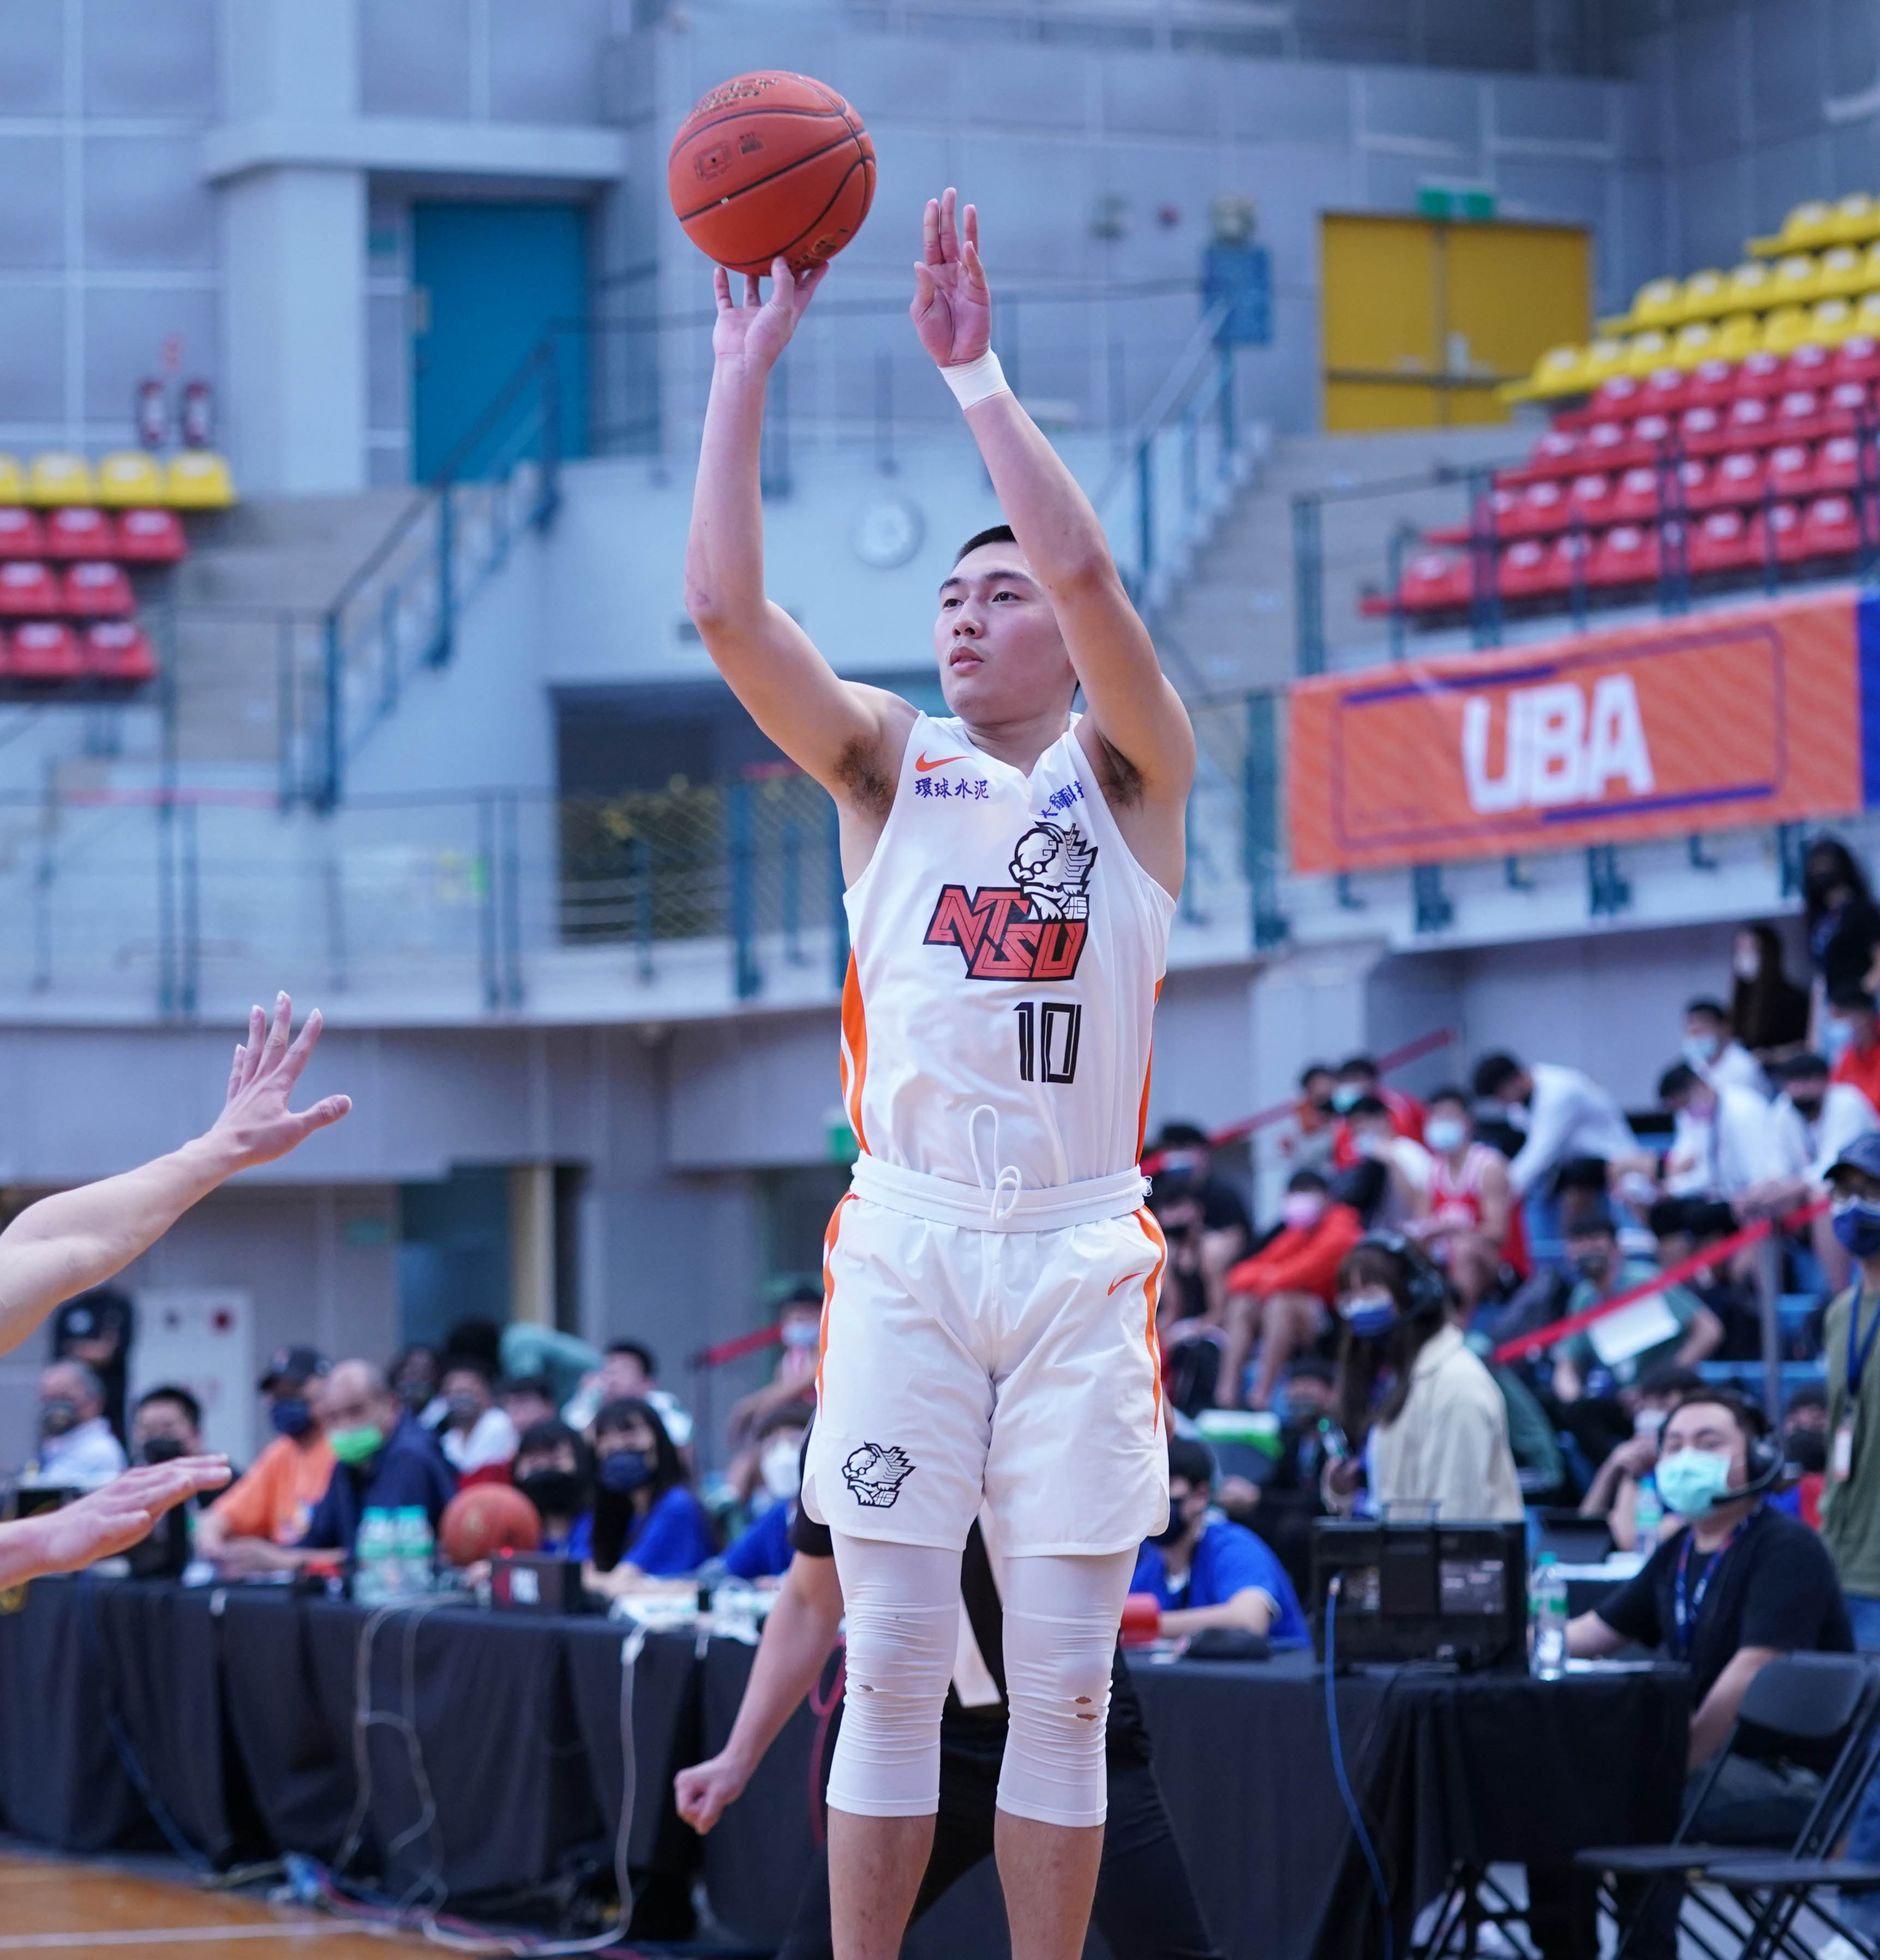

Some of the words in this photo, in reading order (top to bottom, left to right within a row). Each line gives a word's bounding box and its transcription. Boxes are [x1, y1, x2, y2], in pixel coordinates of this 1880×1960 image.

[915, 777, 990, 800] 環球水泥
[1461, 674, 1655, 815] UBA
[923, 884, 1089, 981] NTSU
[1013, 1002, 1082, 1084] 10
